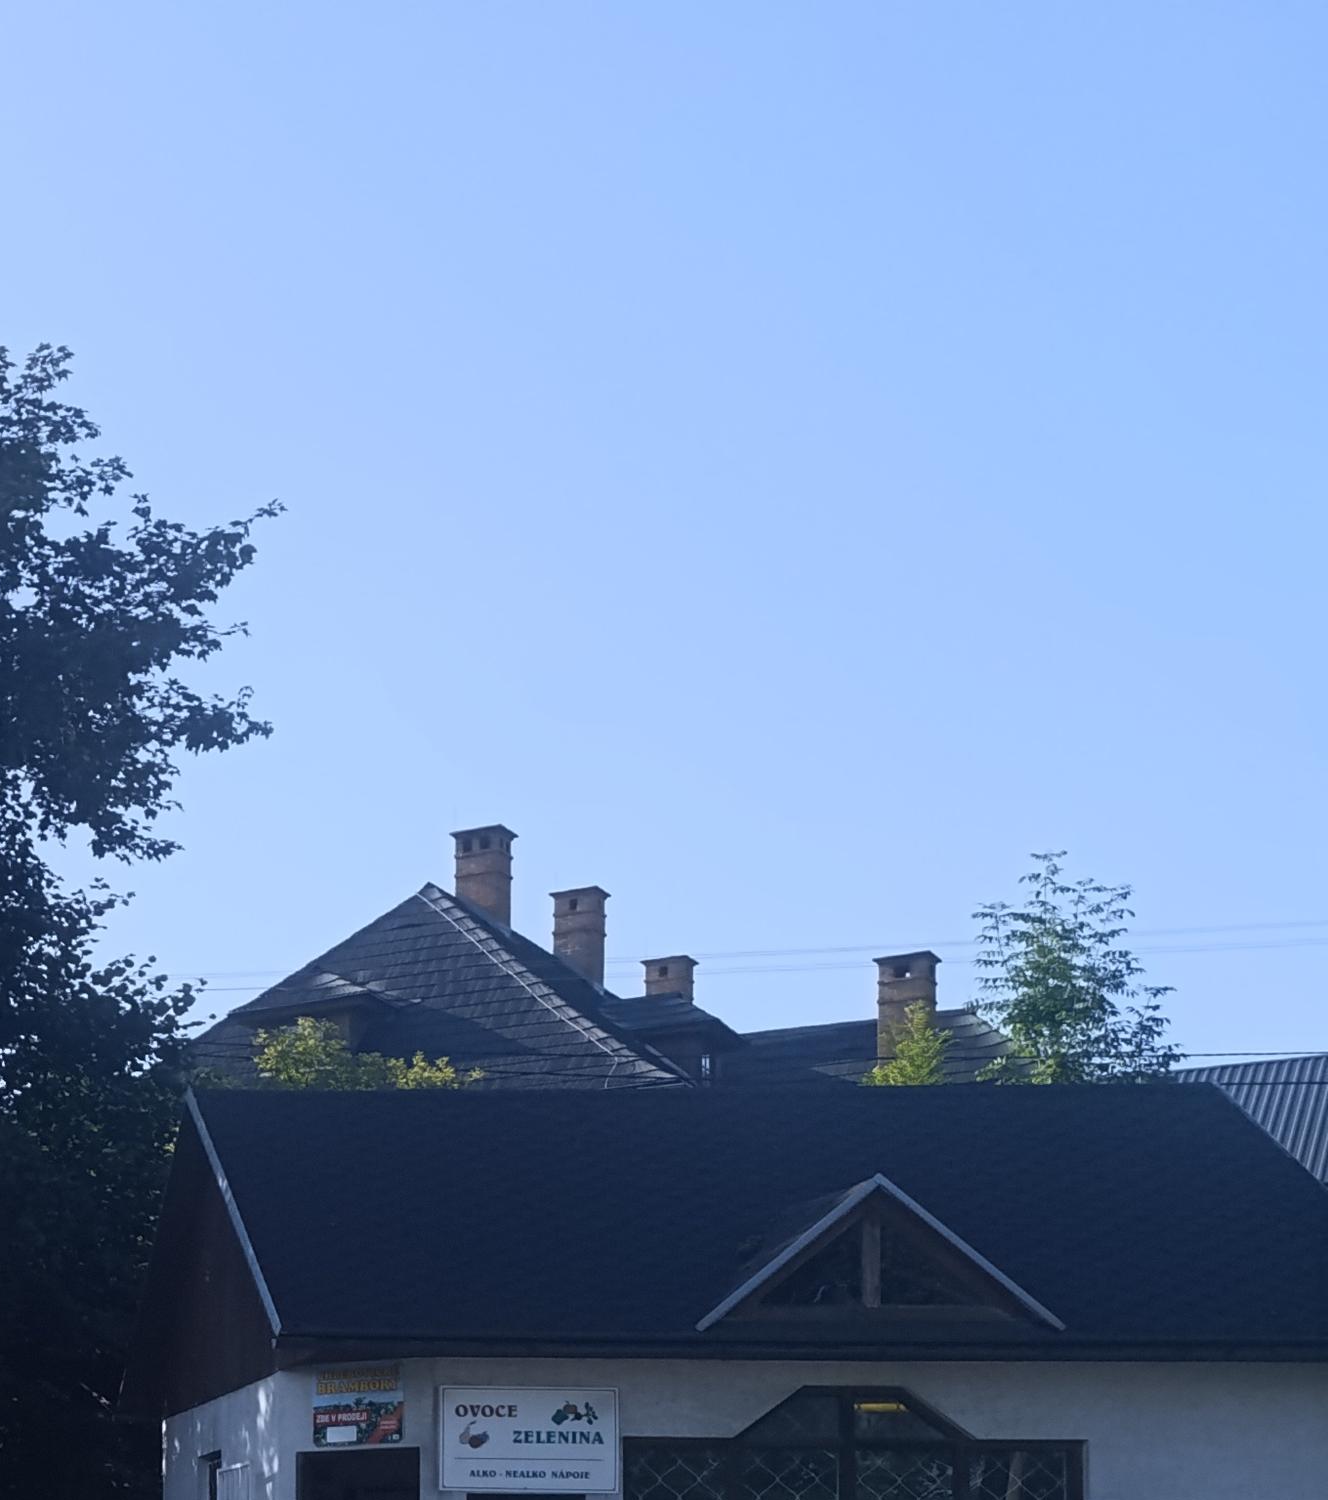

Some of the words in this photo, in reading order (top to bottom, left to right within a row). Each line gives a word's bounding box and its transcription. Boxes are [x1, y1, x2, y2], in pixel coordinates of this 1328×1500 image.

[317, 1378, 399, 1395] BRAMBORY
[454, 1404, 518, 1418] OVOCE
[512, 1430, 605, 1445] ZELENINA
[469, 1469, 497, 1478] ALKO
[505, 1469, 547, 1479] NEALKO
[551, 1468, 591, 1480] NÁPOJE
